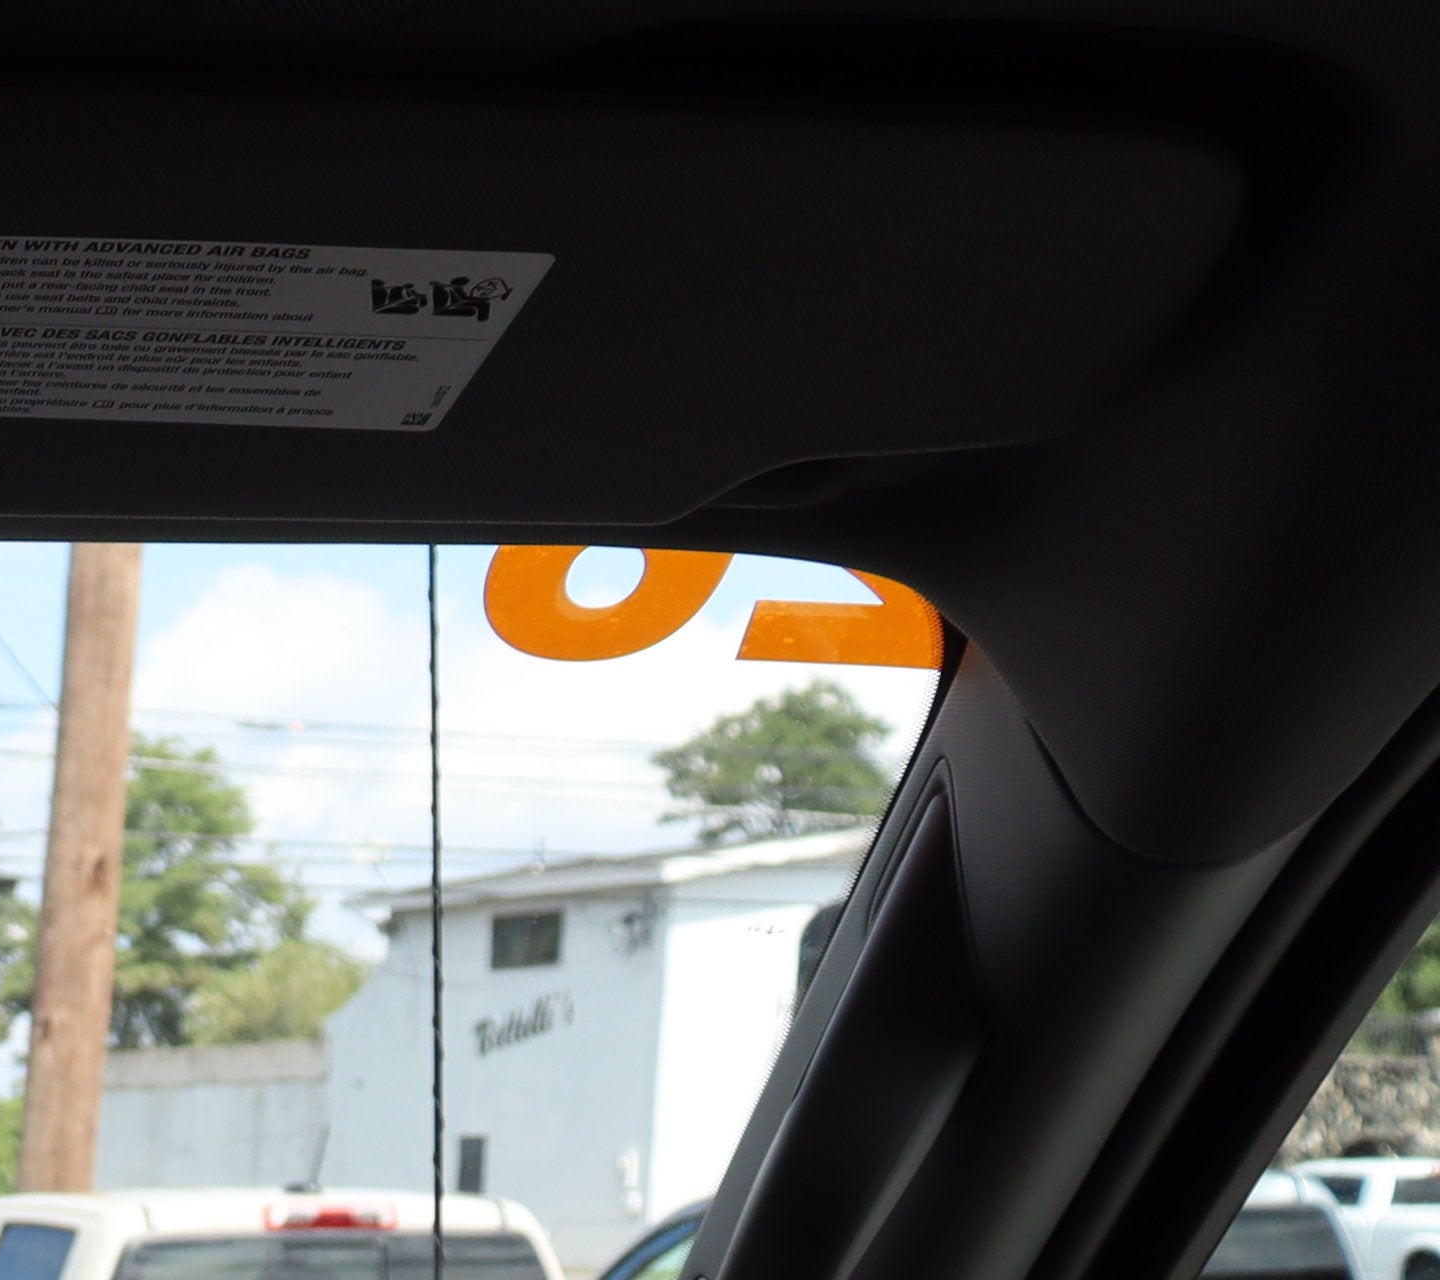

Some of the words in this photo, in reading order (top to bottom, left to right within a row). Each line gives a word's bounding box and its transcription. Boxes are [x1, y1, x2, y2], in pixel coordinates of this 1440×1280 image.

[24, 240, 80, 252] WITH
[82, 241, 202, 255] ADVANCED
[206, 244, 246, 257] AIR
[250, 246, 311, 260] BAGS
[31, 258, 58, 266] can
[61, 257, 80, 266] be
[83, 257, 124, 268] killed
[126, 260, 143, 268] or
[144, 259, 211, 271] seriously
[212, 261, 266, 272] injured
[267, 263, 286, 274] by
[288, 264, 313, 274] the
[314, 265, 336, 274] air
[338, 266, 368, 277] bag.
[40, 328, 81, 339] DES
[84, 328, 138, 341] SACS
[141, 331, 268, 346] GONFLABLES
[270, 335, 406, 351] INTELLIGENTS
